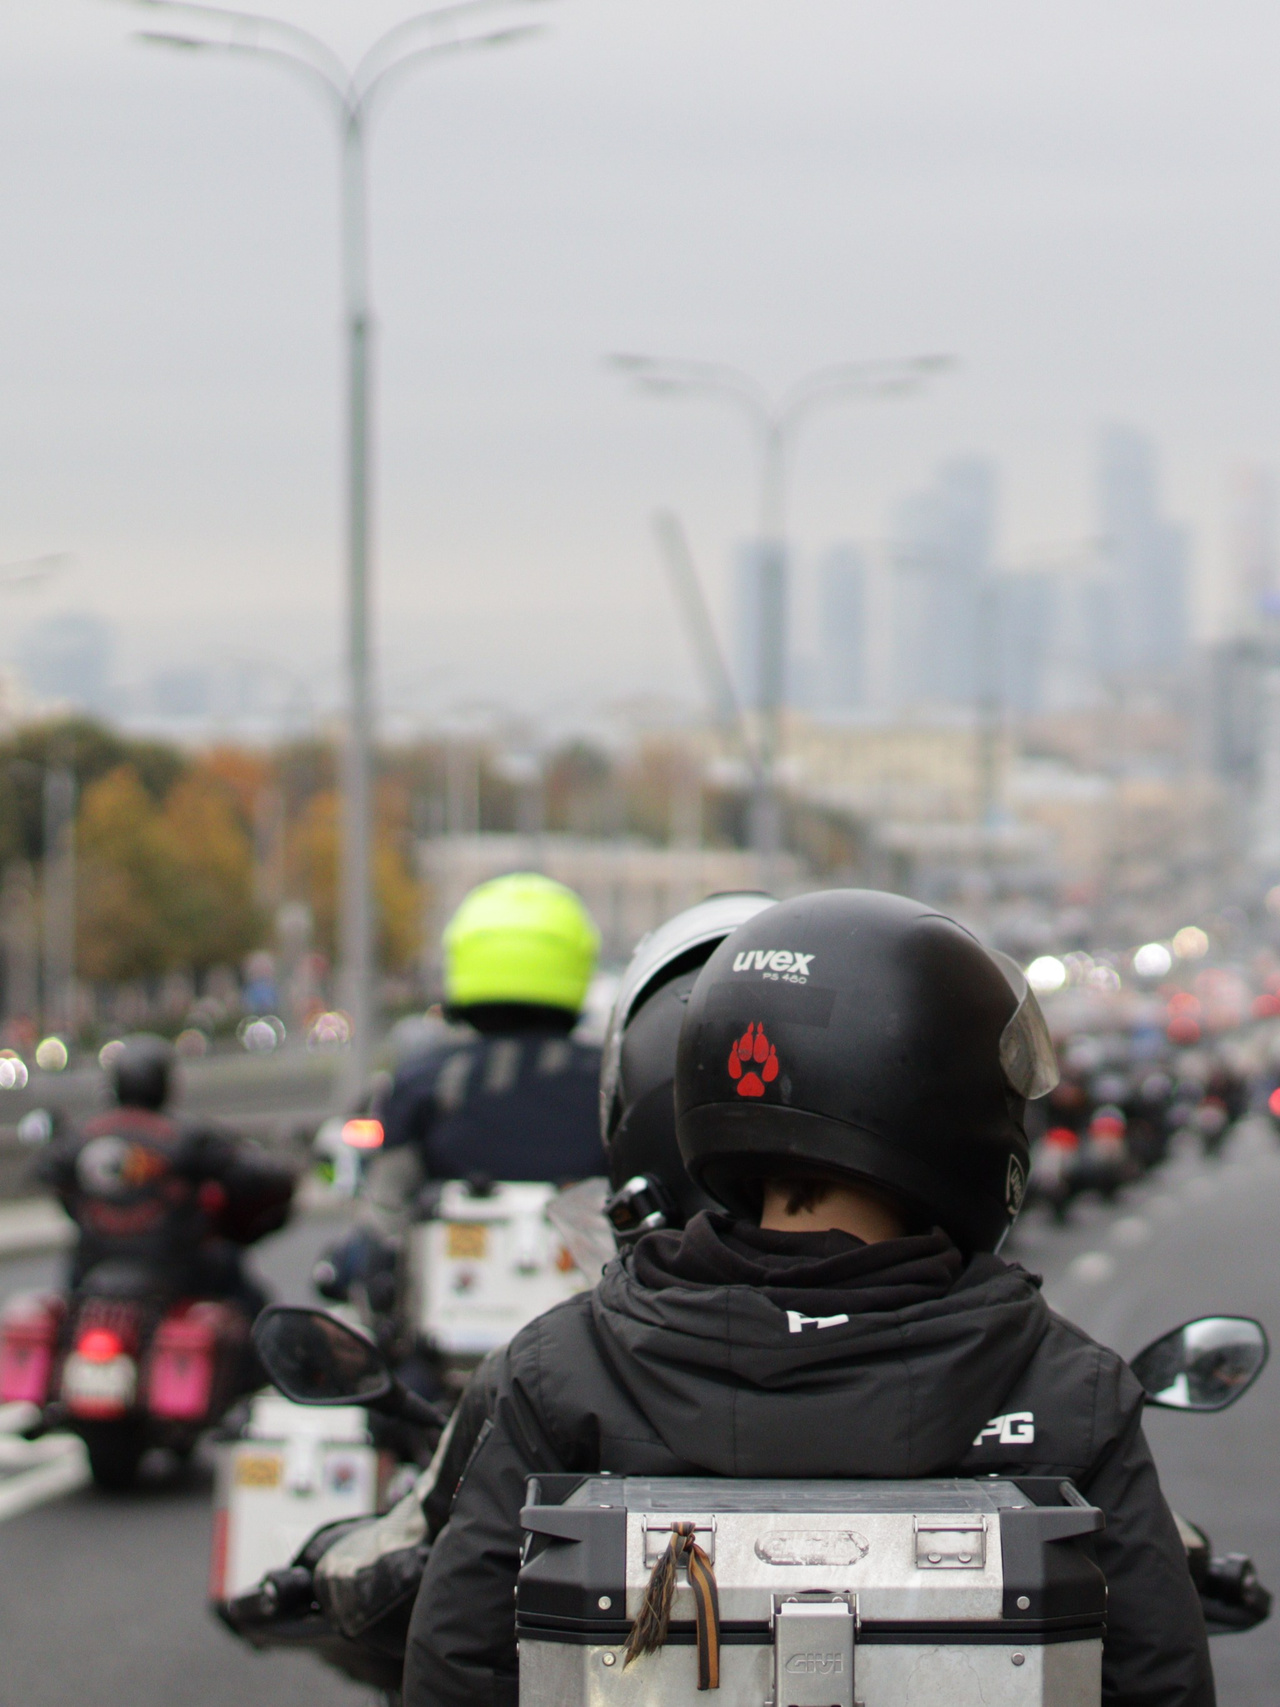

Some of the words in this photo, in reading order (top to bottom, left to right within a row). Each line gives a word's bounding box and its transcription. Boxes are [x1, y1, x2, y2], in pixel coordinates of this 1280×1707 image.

[733, 950, 815, 975] uvex
[763, 973, 779, 981] PS
[785, 1653, 843, 1674] GIVI
